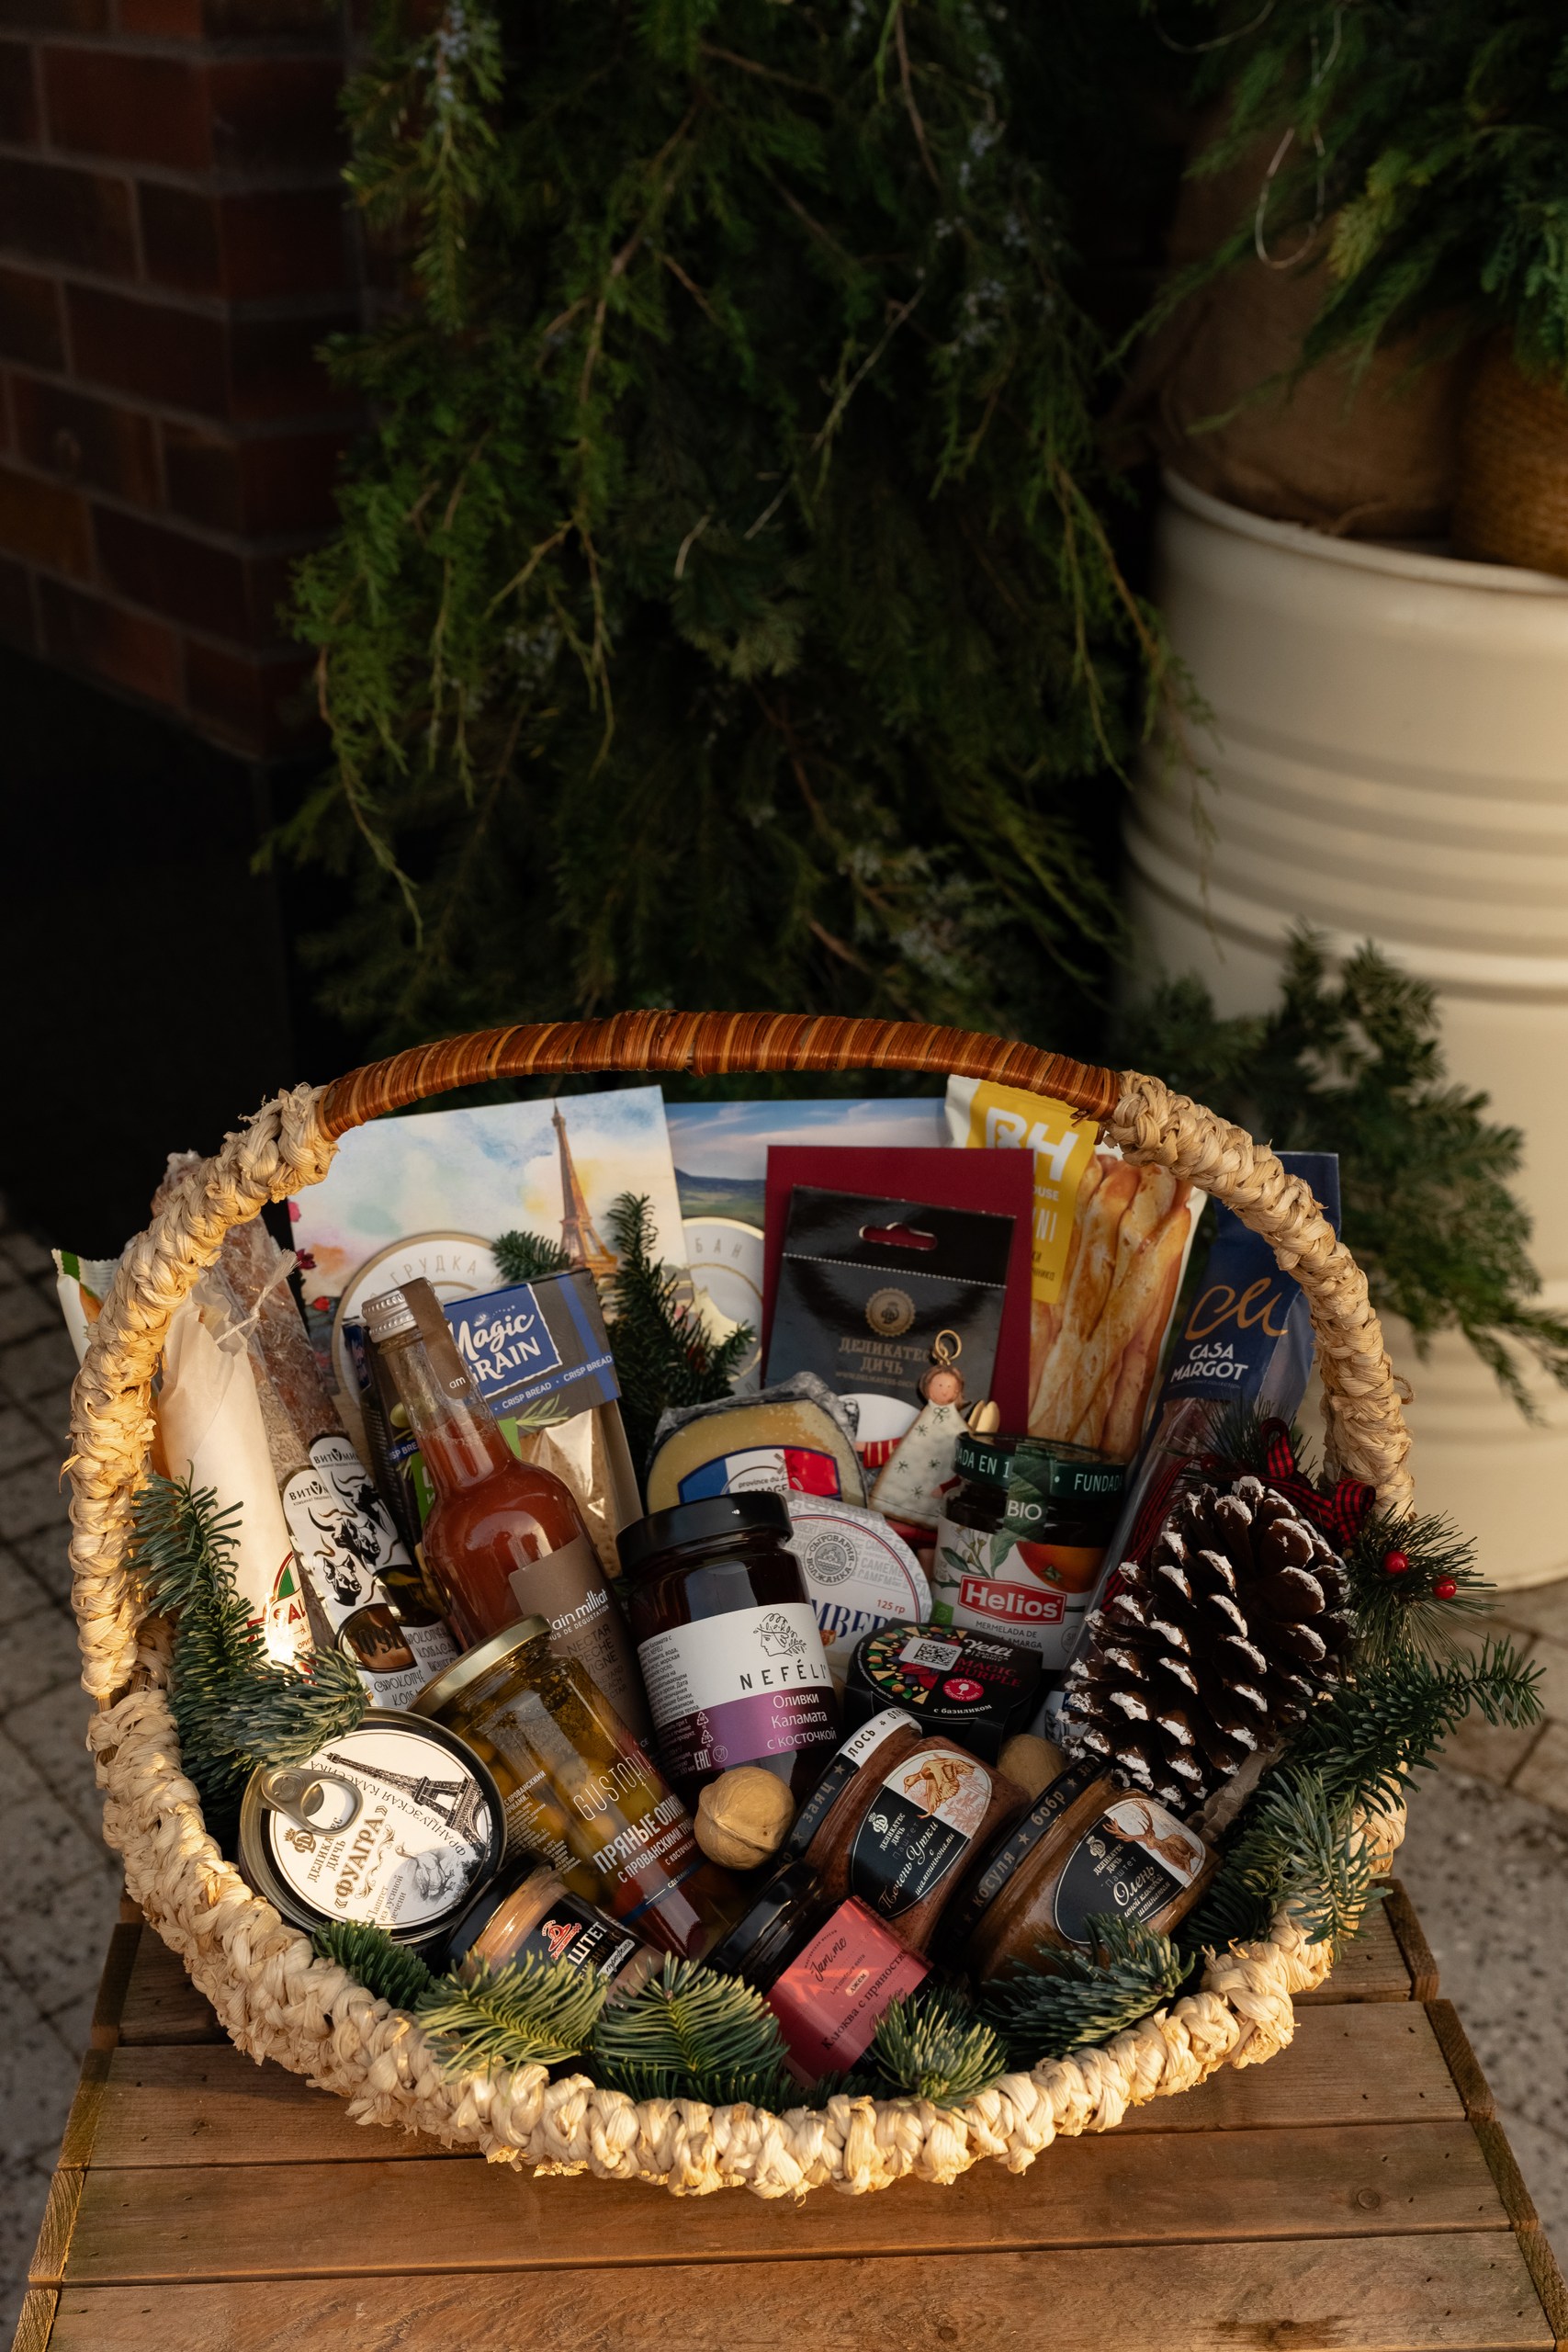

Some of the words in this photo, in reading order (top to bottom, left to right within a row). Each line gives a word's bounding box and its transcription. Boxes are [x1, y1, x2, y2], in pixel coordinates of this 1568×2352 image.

[695, 1238, 742, 1259] БАН
[389, 1255, 478, 1286] ГРУДКА
[447, 1314, 536, 1362] Magic
[1189, 1342, 1234, 1360] CASA
[469, 1336, 542, 1384] RAIN
[563, 1366, 586, 1382] CRISP
[586, 1354, 614, 1373] BREAD
[860, 1356, 903, 1376] ДИЧЬ
[1170, 1362, 1248, 1383] MARGOT
[449, 1376, 467, 1390] am
[502, 1394, 525, 1409] CRISP
[525, 1382, 552, 1399] BREAD
[978, 1455, 998, 1475] EN
[739, 1476, 769, 1489] province
[770, 1476, 780, 1484] du
[1007, 1499, 1043, 1521] BIO
[809, 1533, 855, 1562] СЫРОВАРНЯ
[807, 1557, 852, 1583] ВОЛЖАНКА
[546, 1613, 576, 1633] lain
[575, 1589, 609, 1619] milliat
[877, 1599, 894, 1611] 125
[894, 1603, 906, 1614] гр
[965, 1583, 1059, 1619] Helios
[563, 1626, 573, 1635] DE
[574, 1604, 610, 1630] DEGUSTATION
[976, 1620, 1025, 1638] MERMELADA
[1026, 1630, 1037, 1639] DE
[567, 1623, 612, 1654] NECTAR
[964, 1638, 1014, 1657] Yelli
[739, 1659, 827, 1690] NEFÉLI
[952, 1666, 1022, 1688] PURPLE
[956, 1657, 1018, 1678] MAGIC
[604, 1677, 622, 1693] EACH
[676, 1679, 689, 1690] Дата
[773, 1693, 819, 1709] Оливки
[941, 1703, 992, 1714] базиликом
[771, 1711, 828, 1729] Каламата
[766, 1739, 775, 1749] с
[778, 1727, 837, 1747] косточкой
[310, 1760, 381, 1798] КЛАССИКА
[508, 1770, 547, 1804] ПРОВАНСКИМИ
[572, 1750, 656, 1821] GUSTORIA
[802, 1781, 836, 1824] заяц
[1030, 1790, 1066, 1826] бобр
[381, 1791, 466, 1857] ФРАНЦУЗСКАЯ
[879, 1812, 906, 1851] ДЕЛИКАТЕС
[891, 1826, 906, 1847] ДИЧЬ
[307, 1816, 344, 1883] ДЕЛИКАЕС
[325, 1839, 347, 1871] ДИЧЬ
[592, 1813, 661, 1874] ПРЯНЫЕ
[616, 1871, 628, 1883] С
[625, 1828, 682, 1878] ПРОВАНСКИМИ
[893, 1822, 919, 1860] Паштет
[878, 1861, 914, 1911] Печень
[906, 1820, 940, 1867] Утки
[914, 1832, 955, 1897] шампиньонами
[1092, 1842, 1124, 1876] ДЕЛИКАТЕС
[1104, 1855, 1138, 1889] Паштет
[1105, 1856, 1123, 1875] ДИЧЬ
[972, 1849, 1016, 1908] косуля
[1112, 1864, 1156, 1907] Олень
[1139, 1873, 1165, 1905] клюквой
[366, 1884, 389, 1920] Паштет
[379, 1908, 390, 1922] из
[386, 1873, 404, 1909] гусиной
[389, 1891, 407, 1923] печени
[1136, 1880, 1172, 1918] шпинатом
[567, 1921, 608, 1966] ШТЕТ
[810, 1936, 847, 1983] Jam.me
[849, 1973, 867, 1995] джем
[821, 2008, 860, 2051] Клюква
[857, 2000, 866, 2009] с
